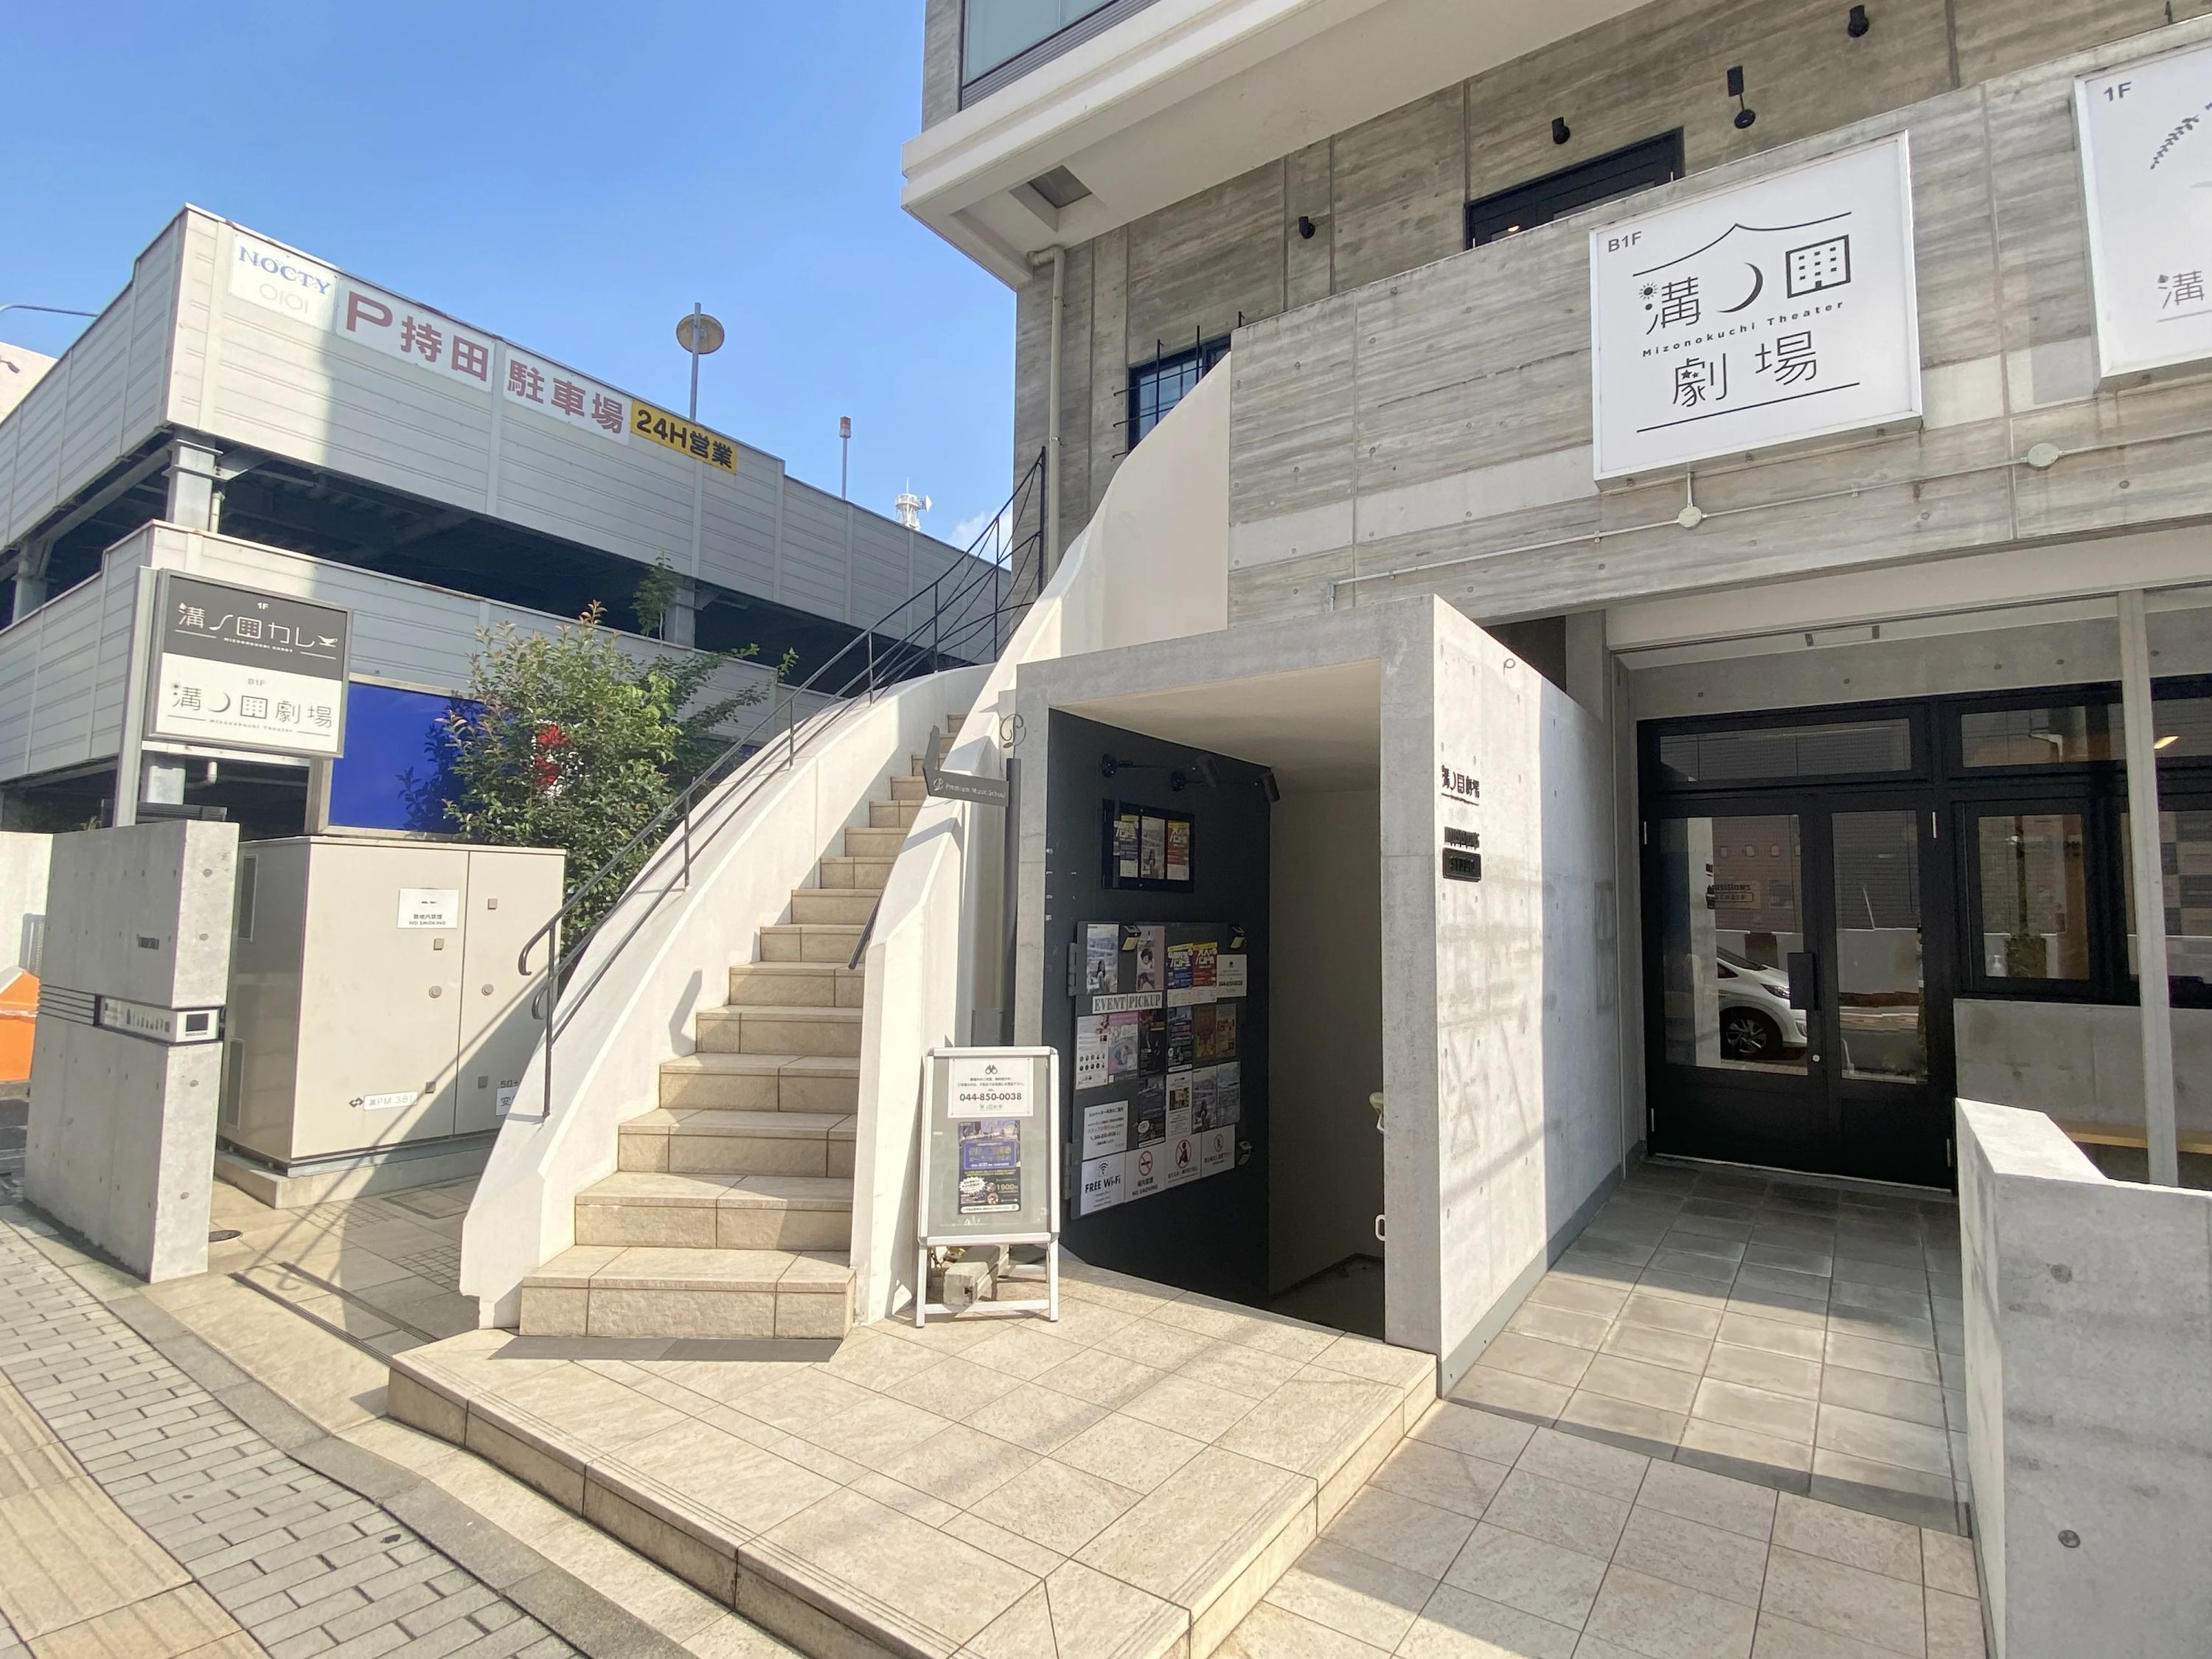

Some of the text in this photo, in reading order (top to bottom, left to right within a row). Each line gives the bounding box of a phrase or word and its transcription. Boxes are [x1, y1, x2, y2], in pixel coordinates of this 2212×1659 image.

[2104, 81, 2132, 101] 1F
[1608, 231, 1642, 252] B1F
[239, 246, 330, 294] NOCTY
[1643, 301, 1844, 357] Mizonokuchi Theater
[636, 409, 733, 469] 24H営業
[257, 602, 268, 610] 1F
[248, 678, 266, 686] B1F
[946, 783, 970, 793] Premium
[988, 789, 1006, 798] School
[1094, 994, 1161, 1012] EVENT PICKUP
[395, 1095, 412, 1104] 381
[959, 1093, 1022, 1101] 044-850-0038
[1085, 1175, 1121, 1194] FREE Wi-Fi
